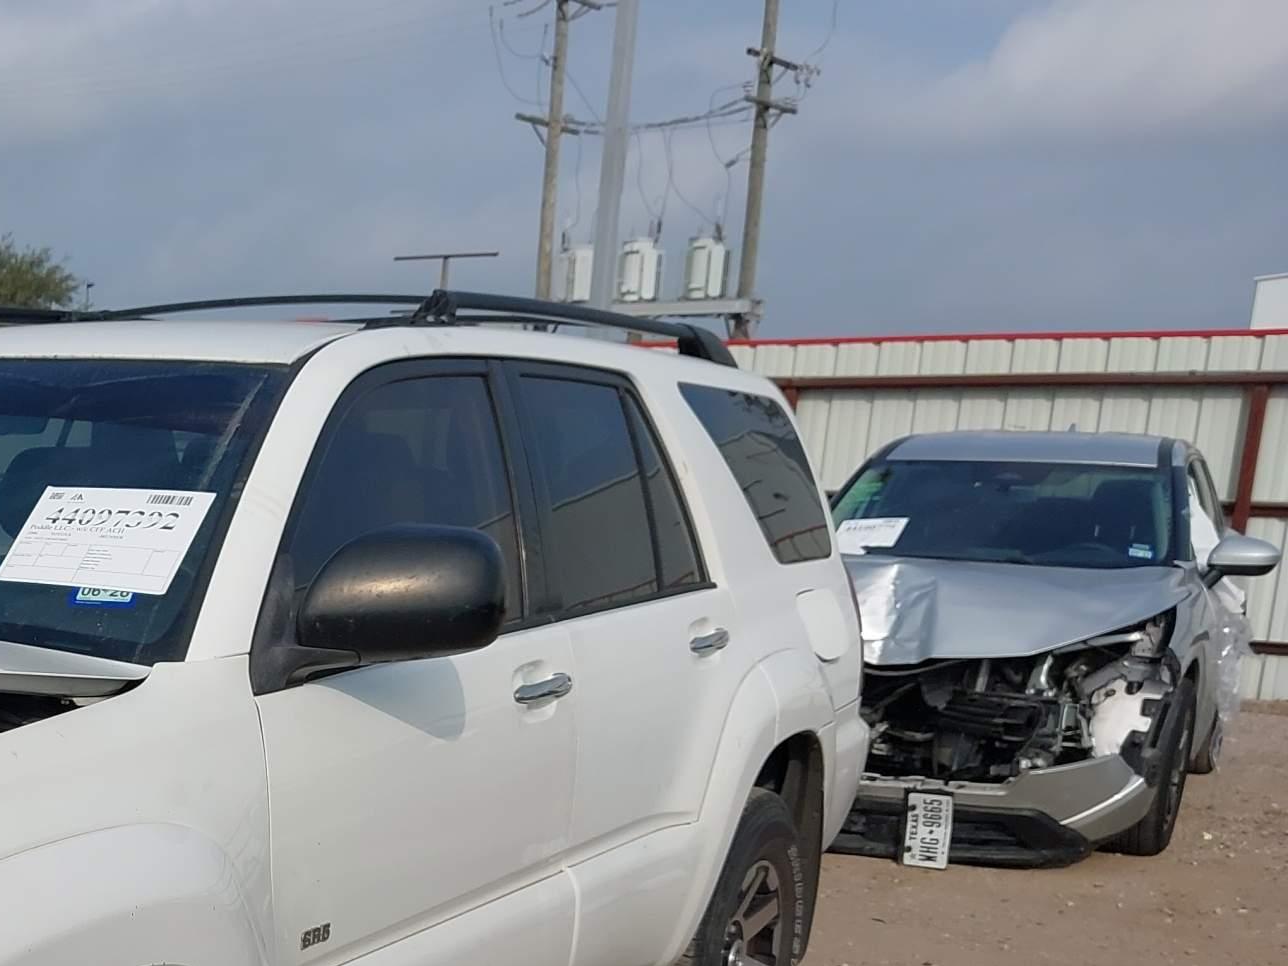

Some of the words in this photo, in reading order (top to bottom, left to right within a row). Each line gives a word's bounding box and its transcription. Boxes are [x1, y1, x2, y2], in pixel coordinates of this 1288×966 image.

[45, 507, 180, 530] 44097392
[909, 813, 919, 840] TEXAS
[922, 799, 943, 828] 9665
